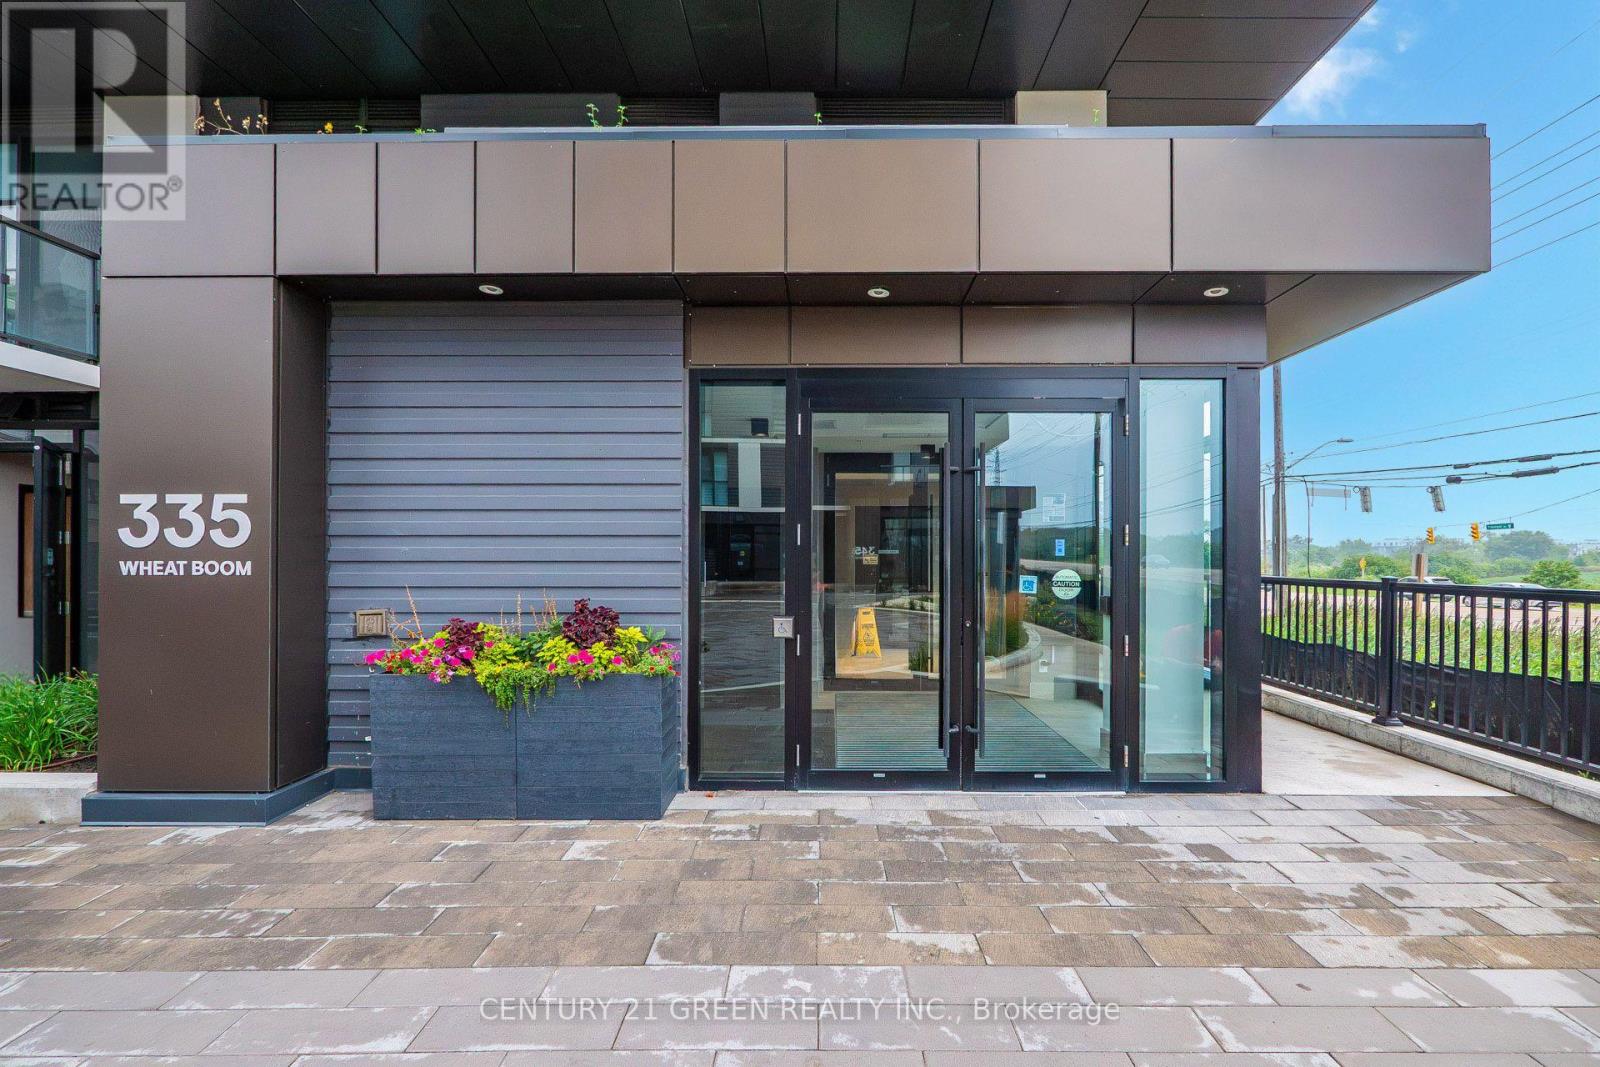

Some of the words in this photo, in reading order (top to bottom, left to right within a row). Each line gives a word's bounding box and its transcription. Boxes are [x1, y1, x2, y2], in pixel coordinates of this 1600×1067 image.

[117, 493, 252, 548] 335
[119, 560, 188, 576] WHEAT
[191, 560, 252, 576] BOOM
